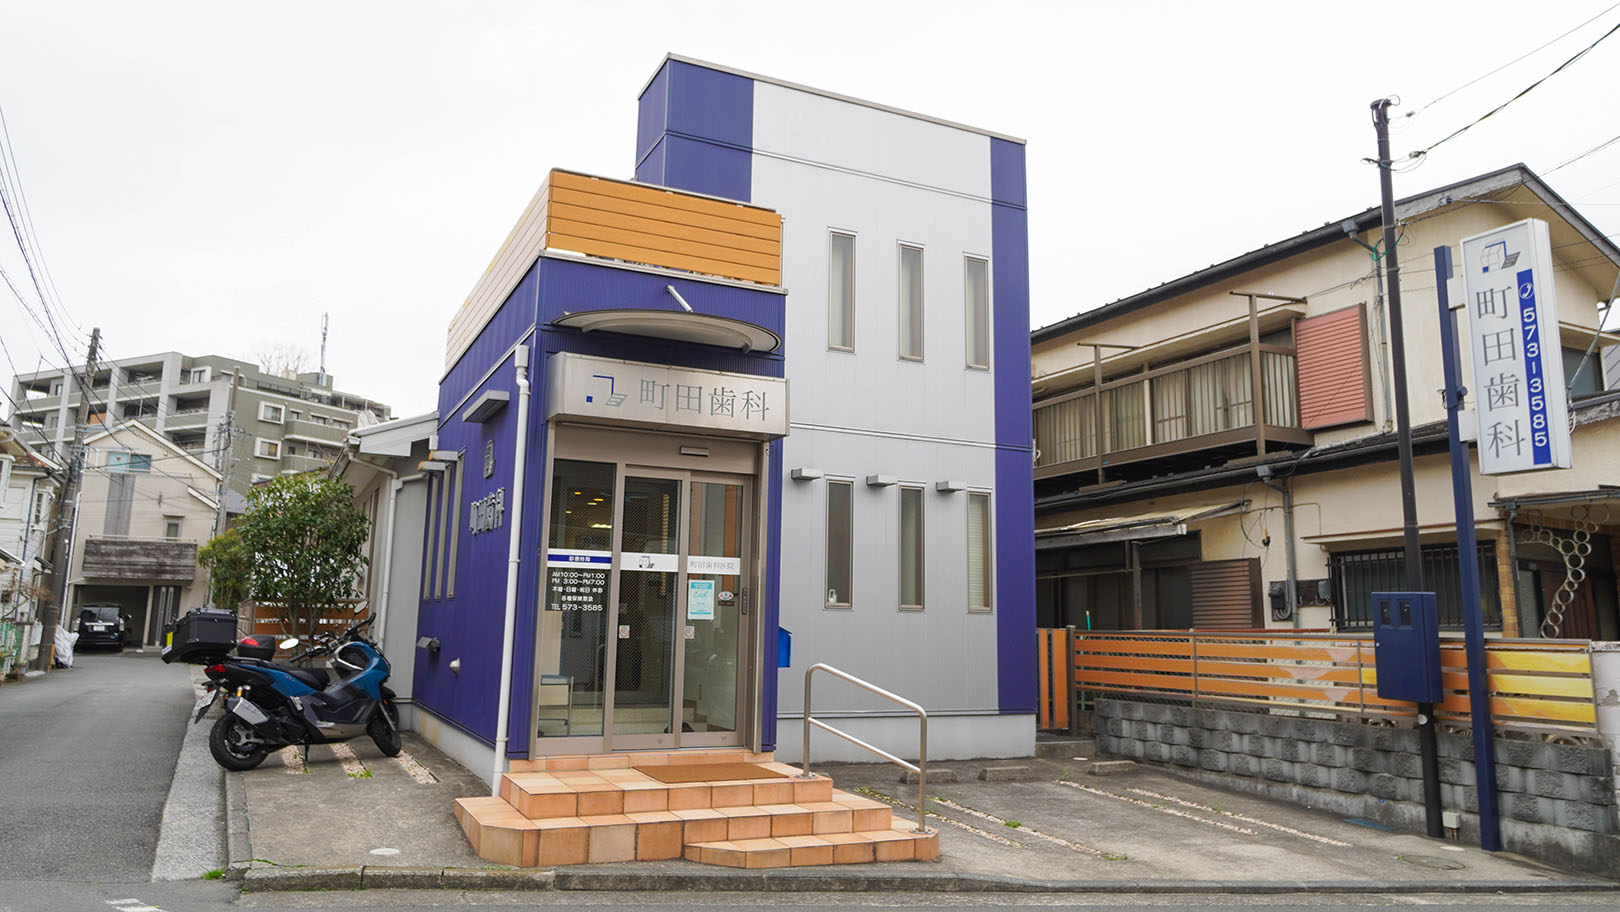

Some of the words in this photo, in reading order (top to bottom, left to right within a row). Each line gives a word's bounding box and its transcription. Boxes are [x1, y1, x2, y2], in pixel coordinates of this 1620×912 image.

[640, 377, 770, 422] 町田歯科
[1475, 285, 1527, 459] 町田歯科
[1522, 306, 1548, 448] 573-3585
[561, 603, 603, 612] 573-3585
